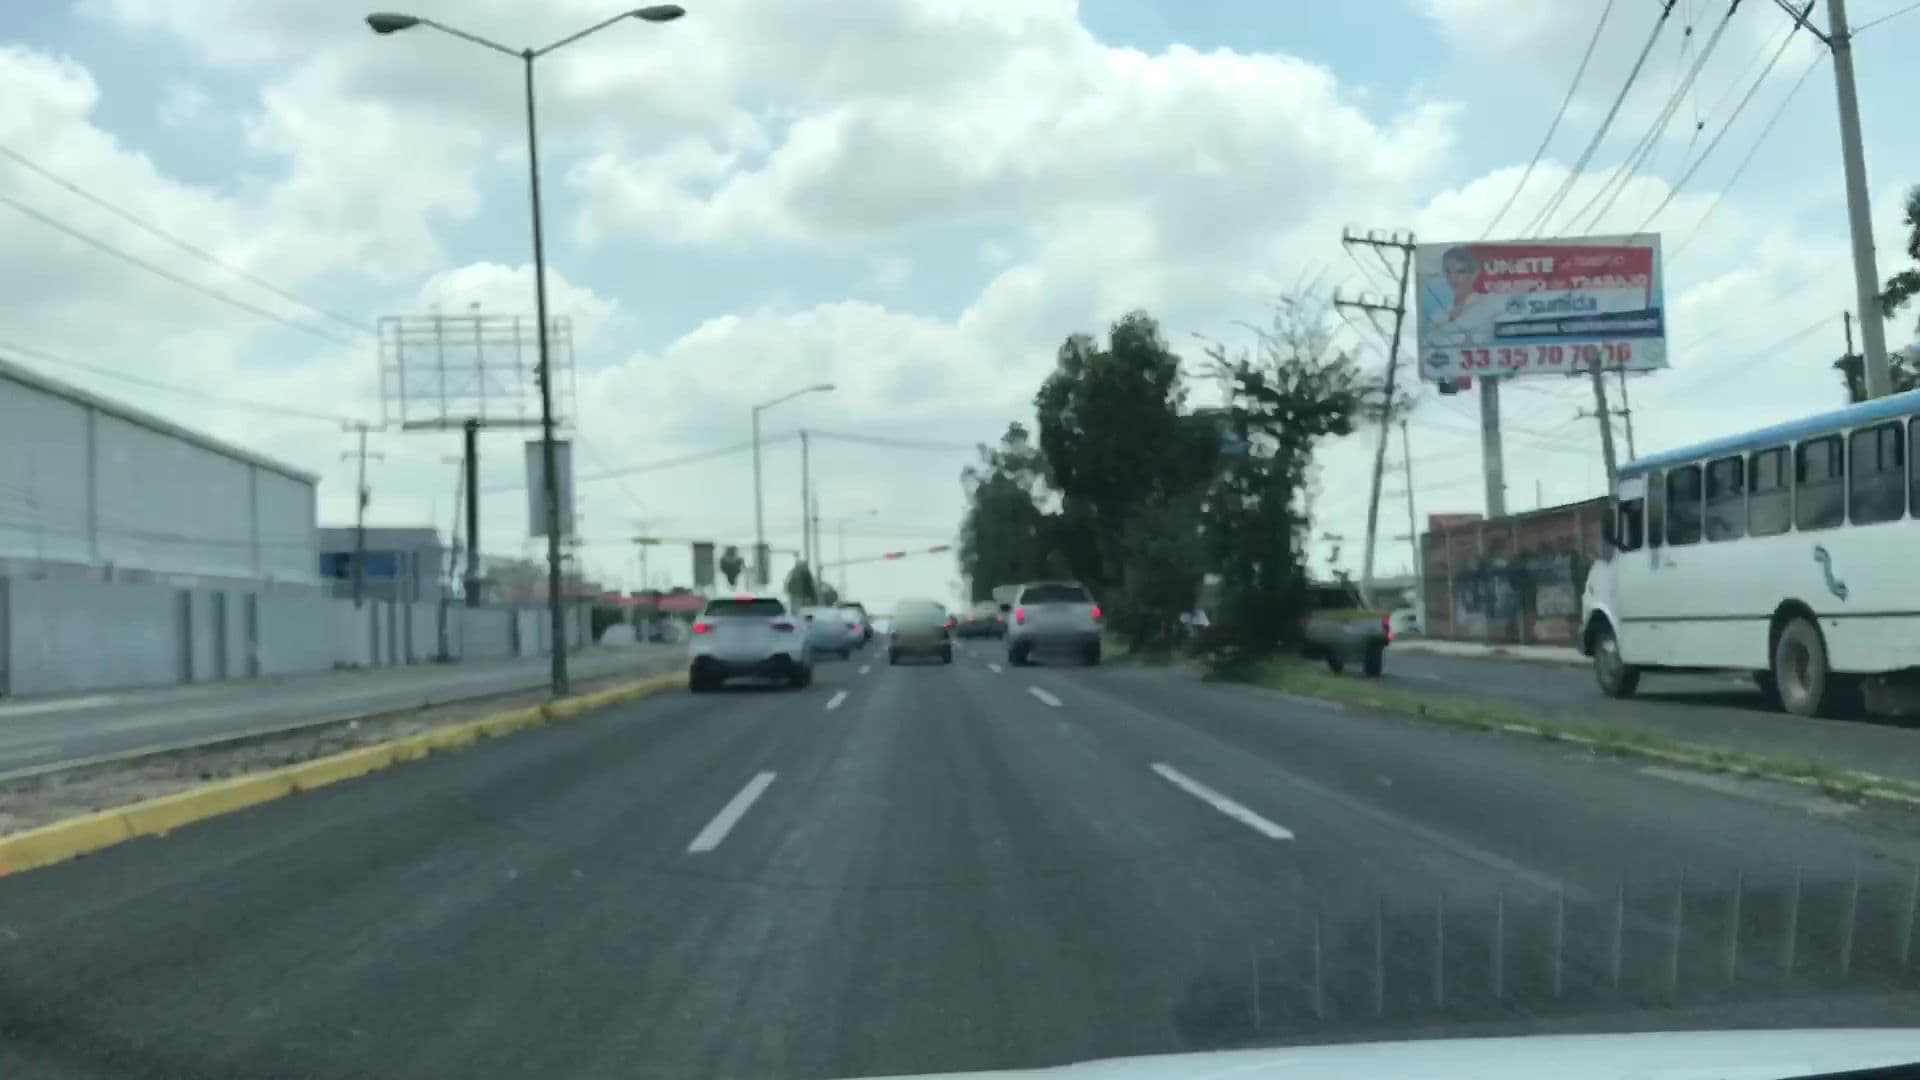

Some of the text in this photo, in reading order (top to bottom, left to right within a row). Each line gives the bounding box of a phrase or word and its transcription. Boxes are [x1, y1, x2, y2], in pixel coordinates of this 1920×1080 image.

[1460, 349, 1490, 371] 33
[1497, 347, 1529, 368] 35
[1536, 344, 1564, 366] 70
